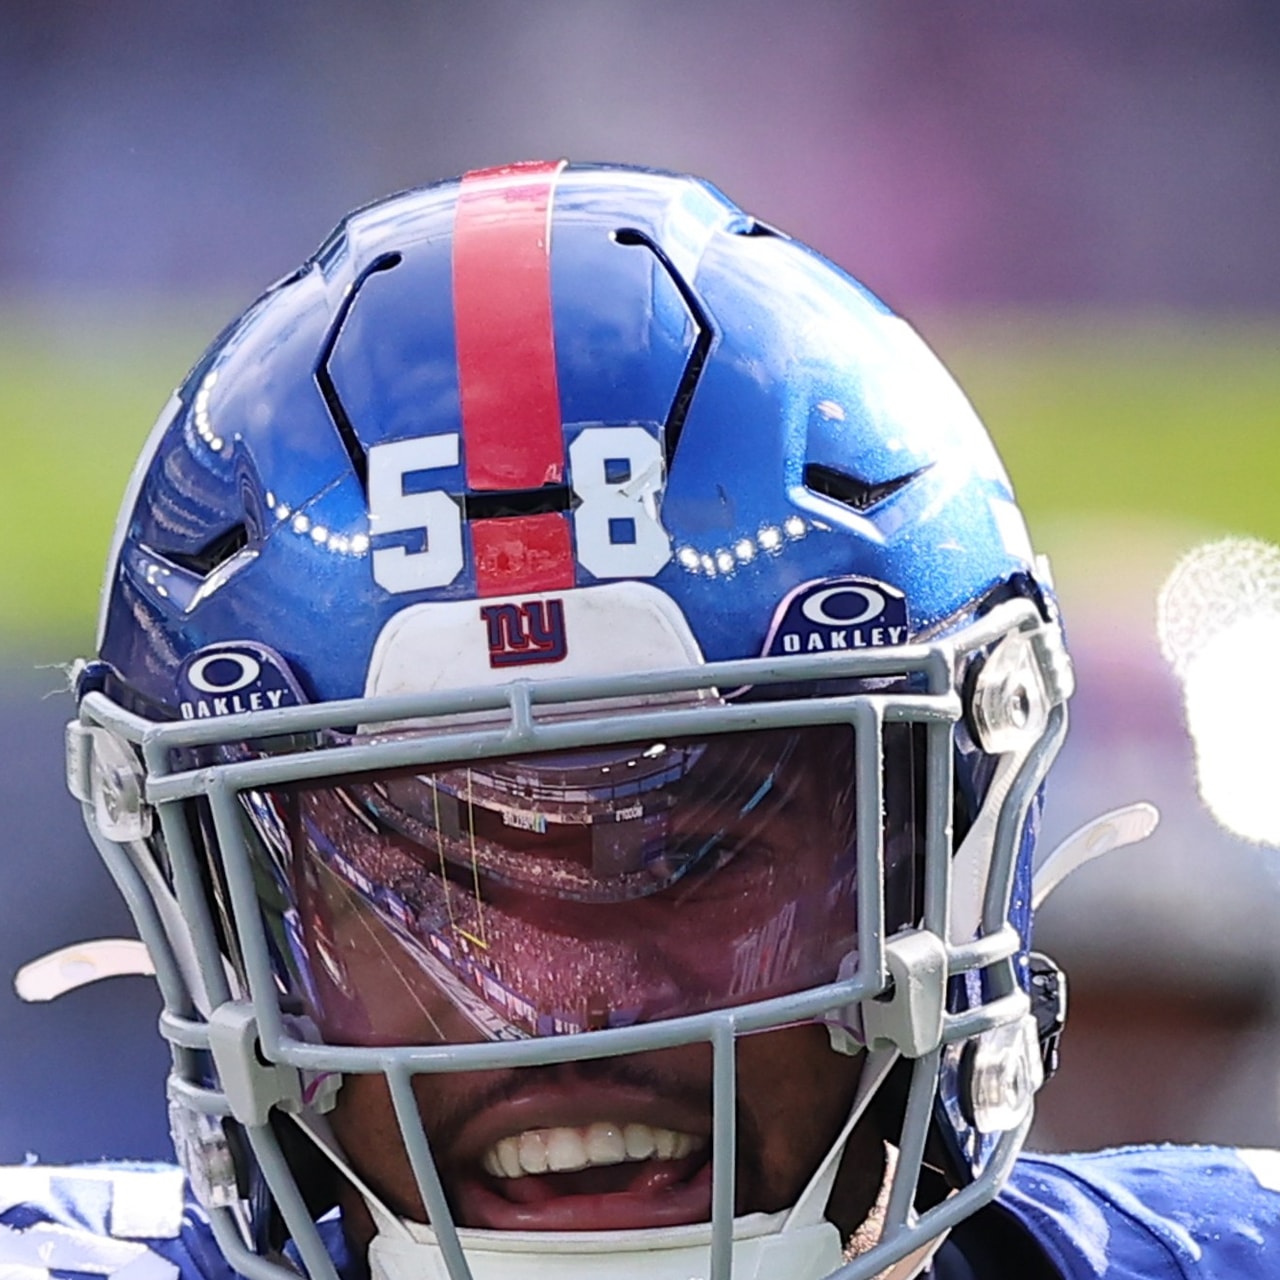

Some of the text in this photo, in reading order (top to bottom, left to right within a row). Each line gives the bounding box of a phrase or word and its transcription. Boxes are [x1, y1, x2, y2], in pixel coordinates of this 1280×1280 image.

[368, 427, 671, 594] 58
[783, 626, 902, 652] OAKLEY
[180, 689, 283, 720] OAKLEY
